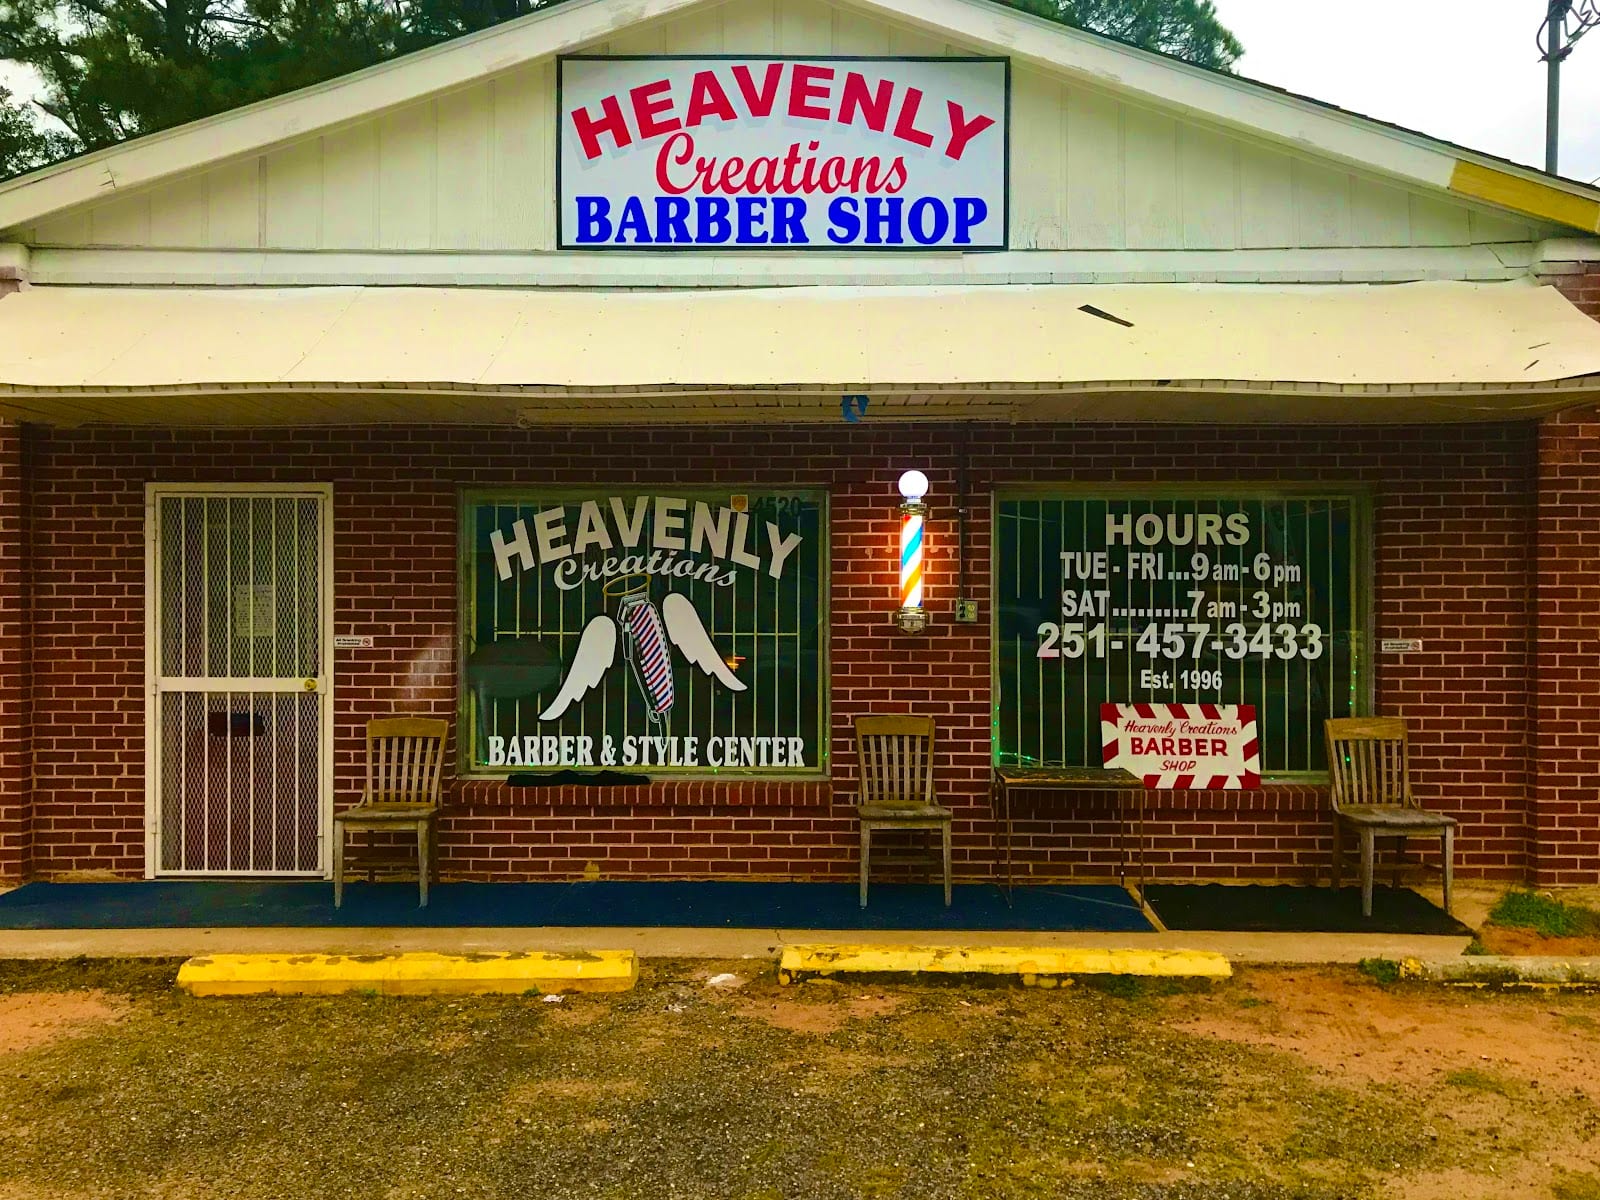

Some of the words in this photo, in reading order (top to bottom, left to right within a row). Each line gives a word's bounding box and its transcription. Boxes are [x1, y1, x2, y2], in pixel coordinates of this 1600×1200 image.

[571, 63, 996, 161] HEAVENLY
[655, 132, 908, 195] Creations
[576, 196, 810, 244] BARBER
[827, 196, 988, 245] SHOP
[489, 495, 803, 582] HEAVENLY
[1106, 513, 1250, 546] HOURS
[553, 549, 738, 591] Creations
[1060, 551, 1108, 580] TUE
[1140, 669, 1174, 689] Est.
[1180, 669, 1223, 690] 1996
[1124, 719, 1176, 737] Heavenly
[1180, 721, 1238, 735] Creations
[488, 735, 594, 767] BARBER
[600, 735, 617, 766] &
[622, 735, 699, 767] STYLE
[706, 736, 805, 767] CENTER
[1130, 737, 1229, 757] BARBER
[1160, 760, 1197, 772] SHOP
